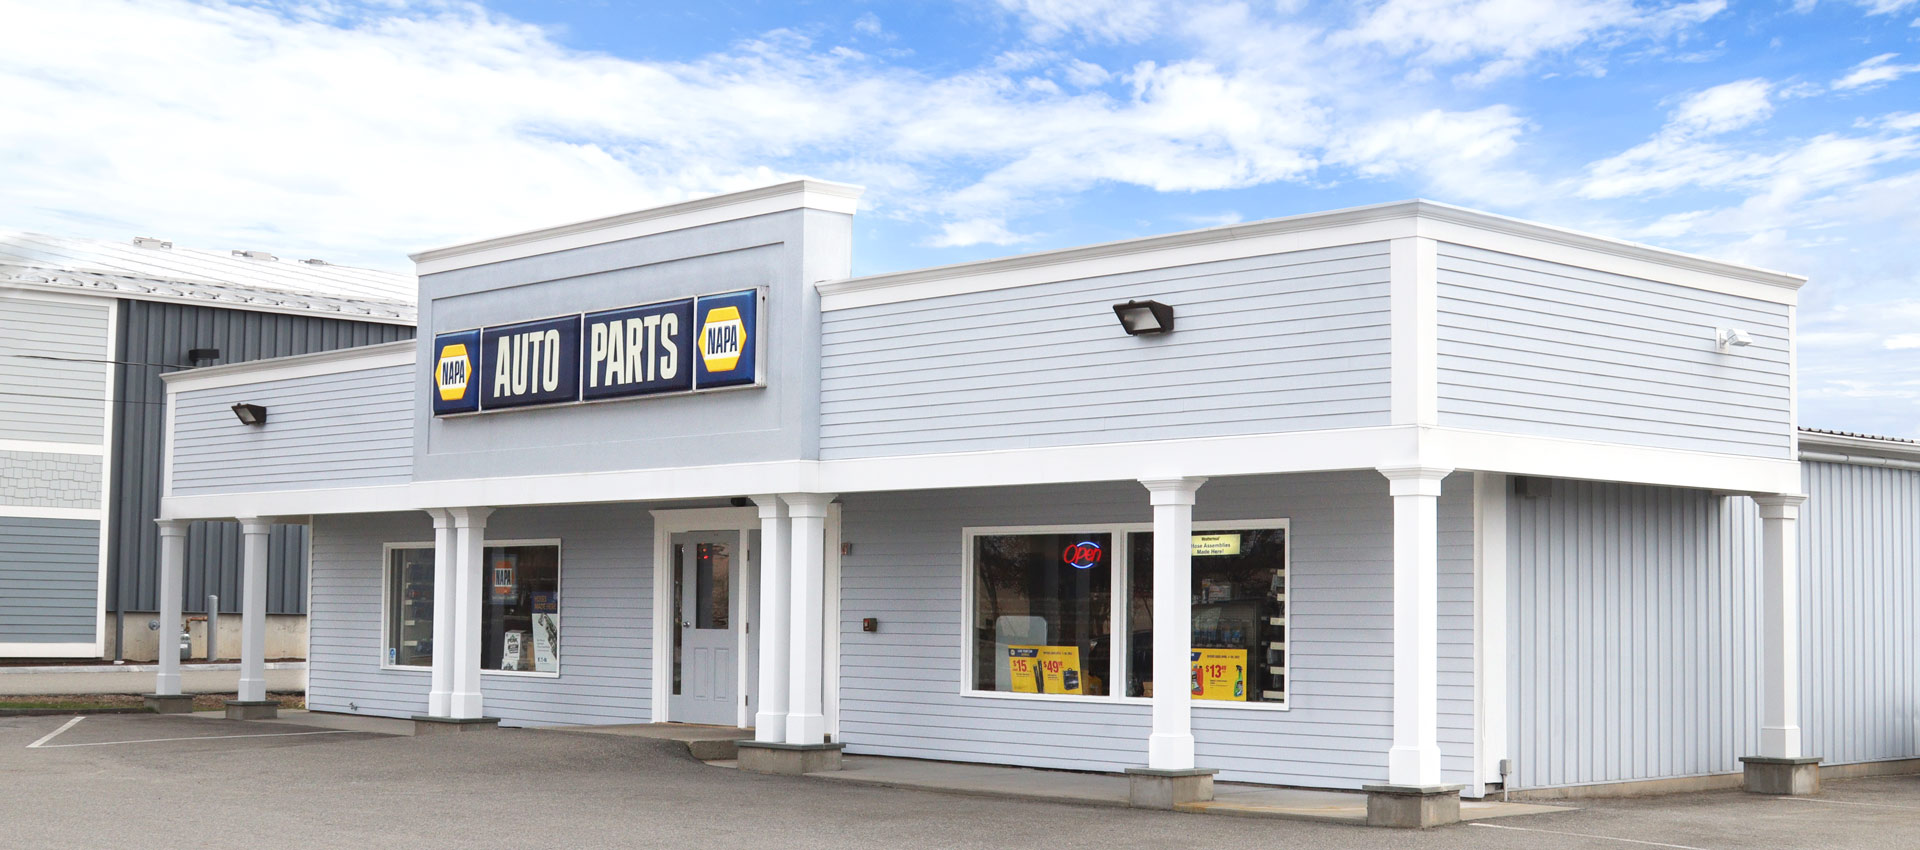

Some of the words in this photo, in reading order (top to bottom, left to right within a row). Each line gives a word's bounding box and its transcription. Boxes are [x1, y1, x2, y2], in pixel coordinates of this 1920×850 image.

[707, 323, 738, 355] NAPA
[493, 329, 560, 398] AUTO
[589, 312, 679, 388] PARTS
[441, 358, 466, 386] NAPA
[1063, 544, 1102, 564] Open
[496, 569, 511, 586] NAPA
